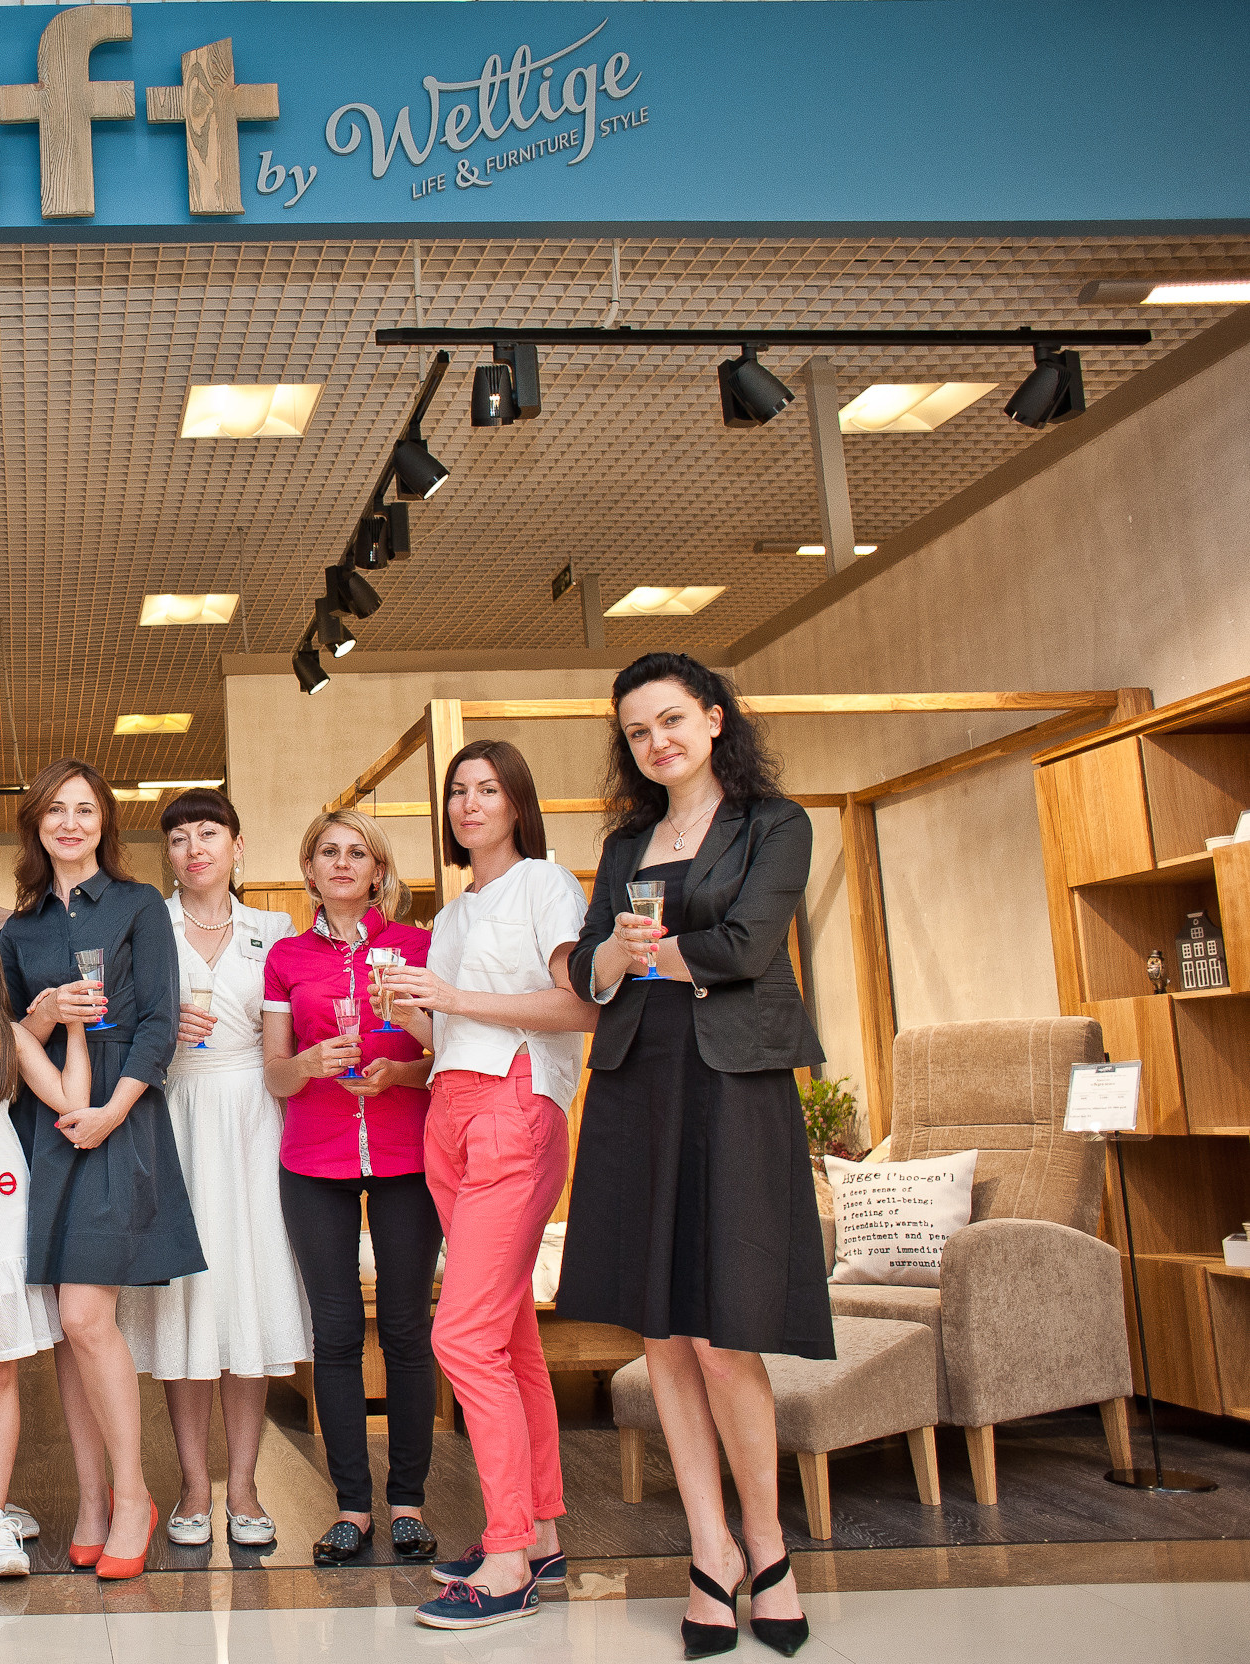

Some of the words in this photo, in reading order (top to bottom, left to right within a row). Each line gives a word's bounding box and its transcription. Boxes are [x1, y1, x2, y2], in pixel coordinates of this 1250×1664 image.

[411, 173, 446, 200] LIFE
[455, 159, 493, 189] &
[485, 128, 580, 175] FURNITURE
[599, 105, 650, 139] STYLE
[256, 151, 318, 208] by
[842, 1172, 881, 1184] Hygge
[843, 1200, 863, 1210] place
[851, 1209, 883, 1219] feeling
[844, 1232, 899, 1244] contentment
[905, 1232, 922, 1240] and
[929, 1232, 950, 1241] peac
[844, 1248, 862, 1257] with
[868, 1246, 890, 1255] your
[896, 1246, 943, 1254] immediat
[889, 1259, 941, 1267] surroundi
